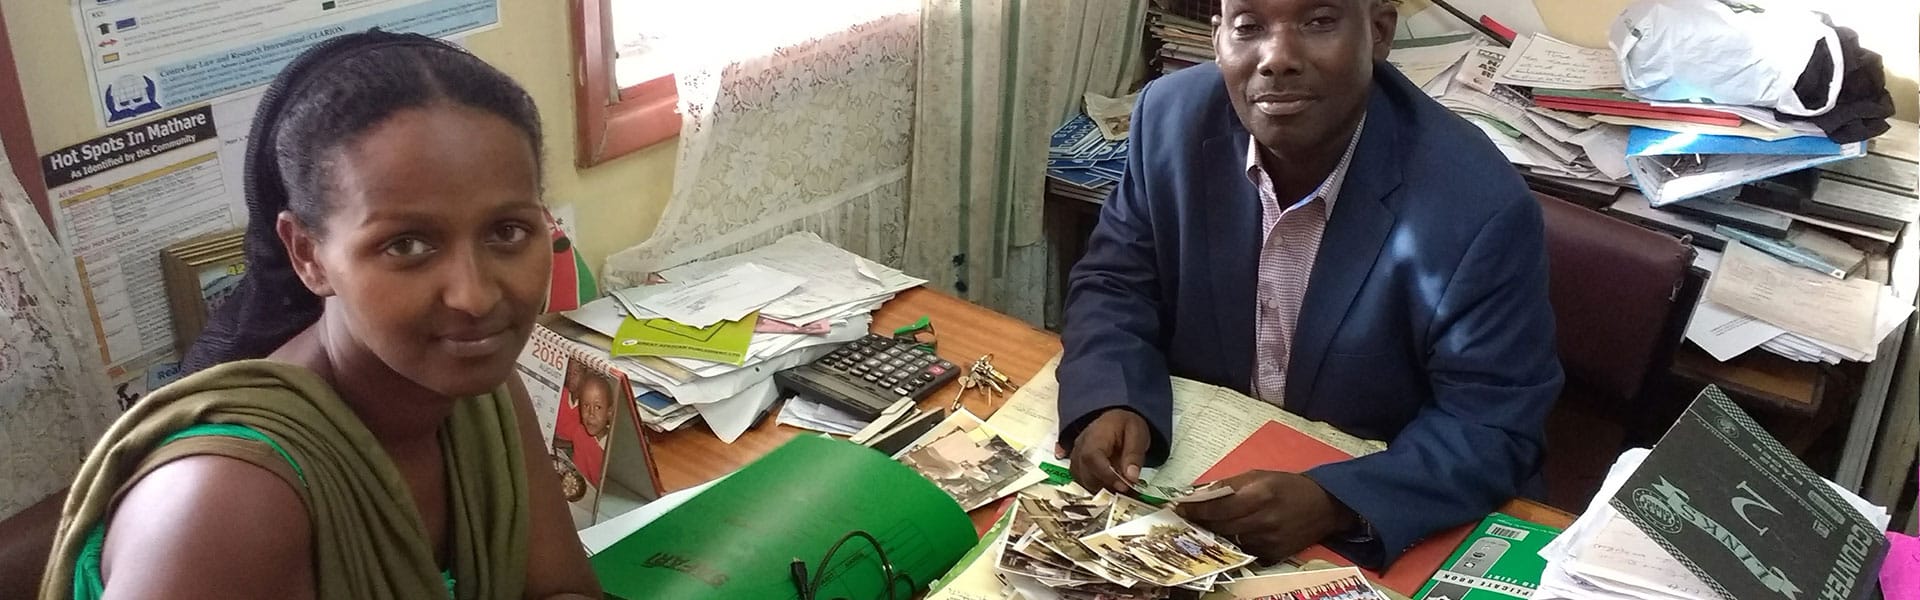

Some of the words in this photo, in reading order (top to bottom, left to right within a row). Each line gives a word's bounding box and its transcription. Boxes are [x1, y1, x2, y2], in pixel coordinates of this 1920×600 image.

[160, 65, 185, 78] Centre
[199, 58, 214, 69] Law
[216, 54, 230, 65] and
[231, 48, 262, 61] Research
[51, 151, 81, 171] Hot
[82, 136, 125, 160] Spots
[127, 131, 146, 146] In
[148, 112, 207, 141] Mathare
[70, 169, 83, 180] As
[83, 156, 124, 178] Identified
[125, 152, 136, 164] by
[136, 149, 151, 160] the
[151, 134, 197, 154] Community
[532, 342, 564, 371] 2016
[1731, 480, 1785, 536] 2
[1681, 503, 1772, 582] LINKS
[1820, 523, 1874, 600] COUNTER
[1443, 574, 1474, 584] BOOK
